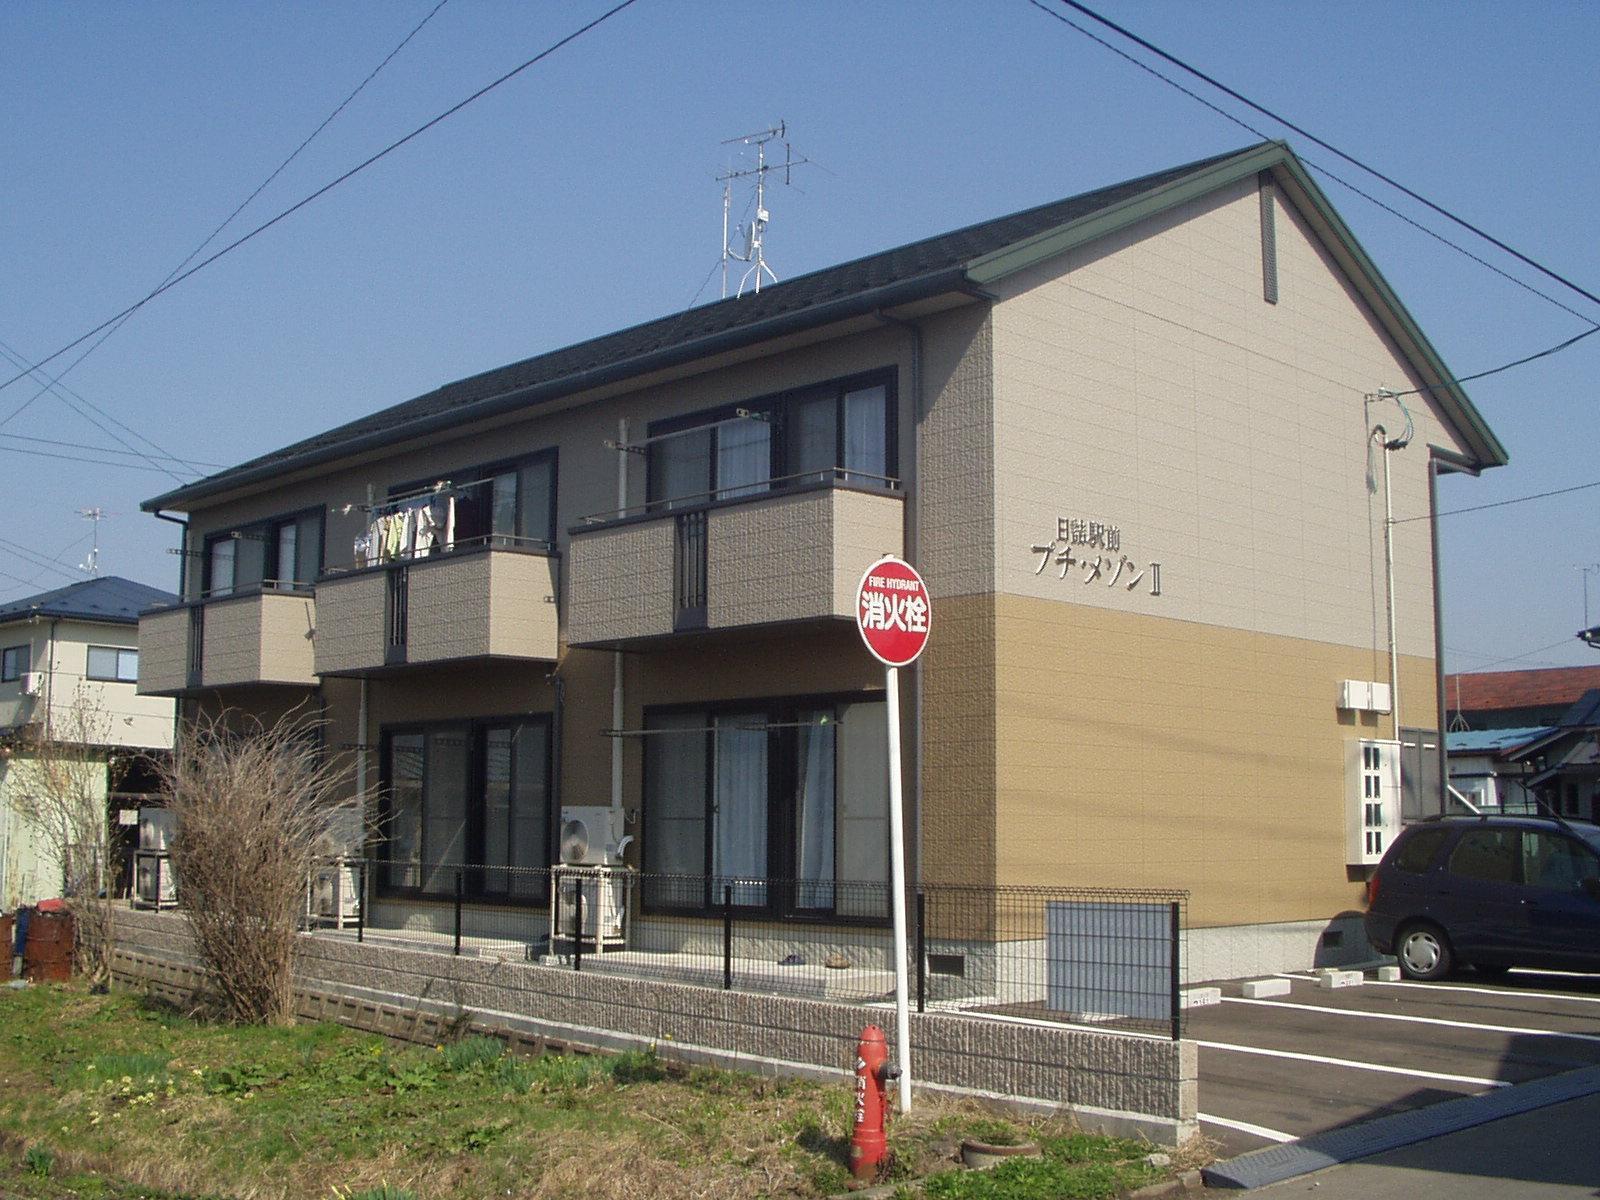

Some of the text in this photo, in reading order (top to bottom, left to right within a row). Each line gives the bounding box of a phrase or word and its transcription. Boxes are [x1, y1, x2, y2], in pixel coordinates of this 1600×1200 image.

[868, 575, 920, 592] FIRE HYDRANT
[861, 590, 928, 633] 消火栓
